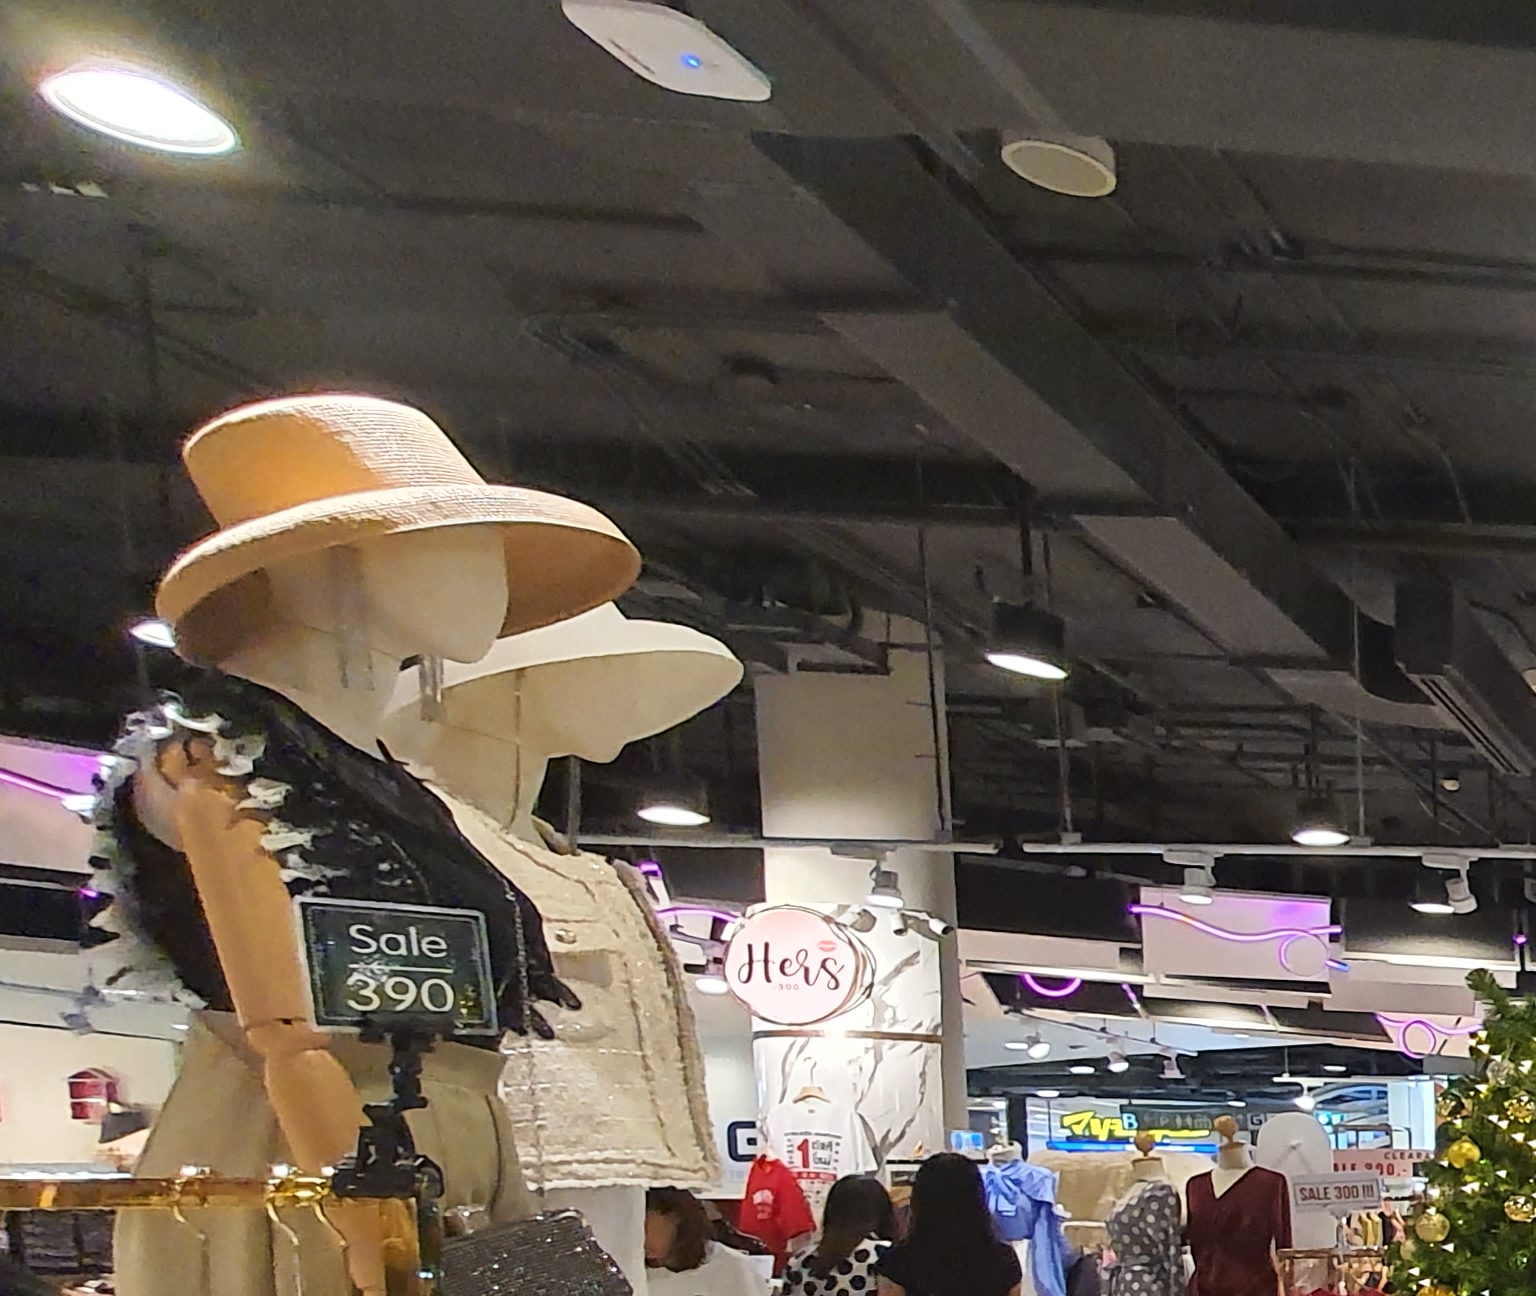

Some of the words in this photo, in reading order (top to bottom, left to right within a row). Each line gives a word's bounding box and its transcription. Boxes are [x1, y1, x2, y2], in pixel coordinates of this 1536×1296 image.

[348, 924, 448, 958] Sale
[737, 941, 845, 991] Hers
[346, 971, 455, 1012] 390
[1300, 1187, 1331, 1201] SALE
[1334, 1185, 1359, 1200] 300
